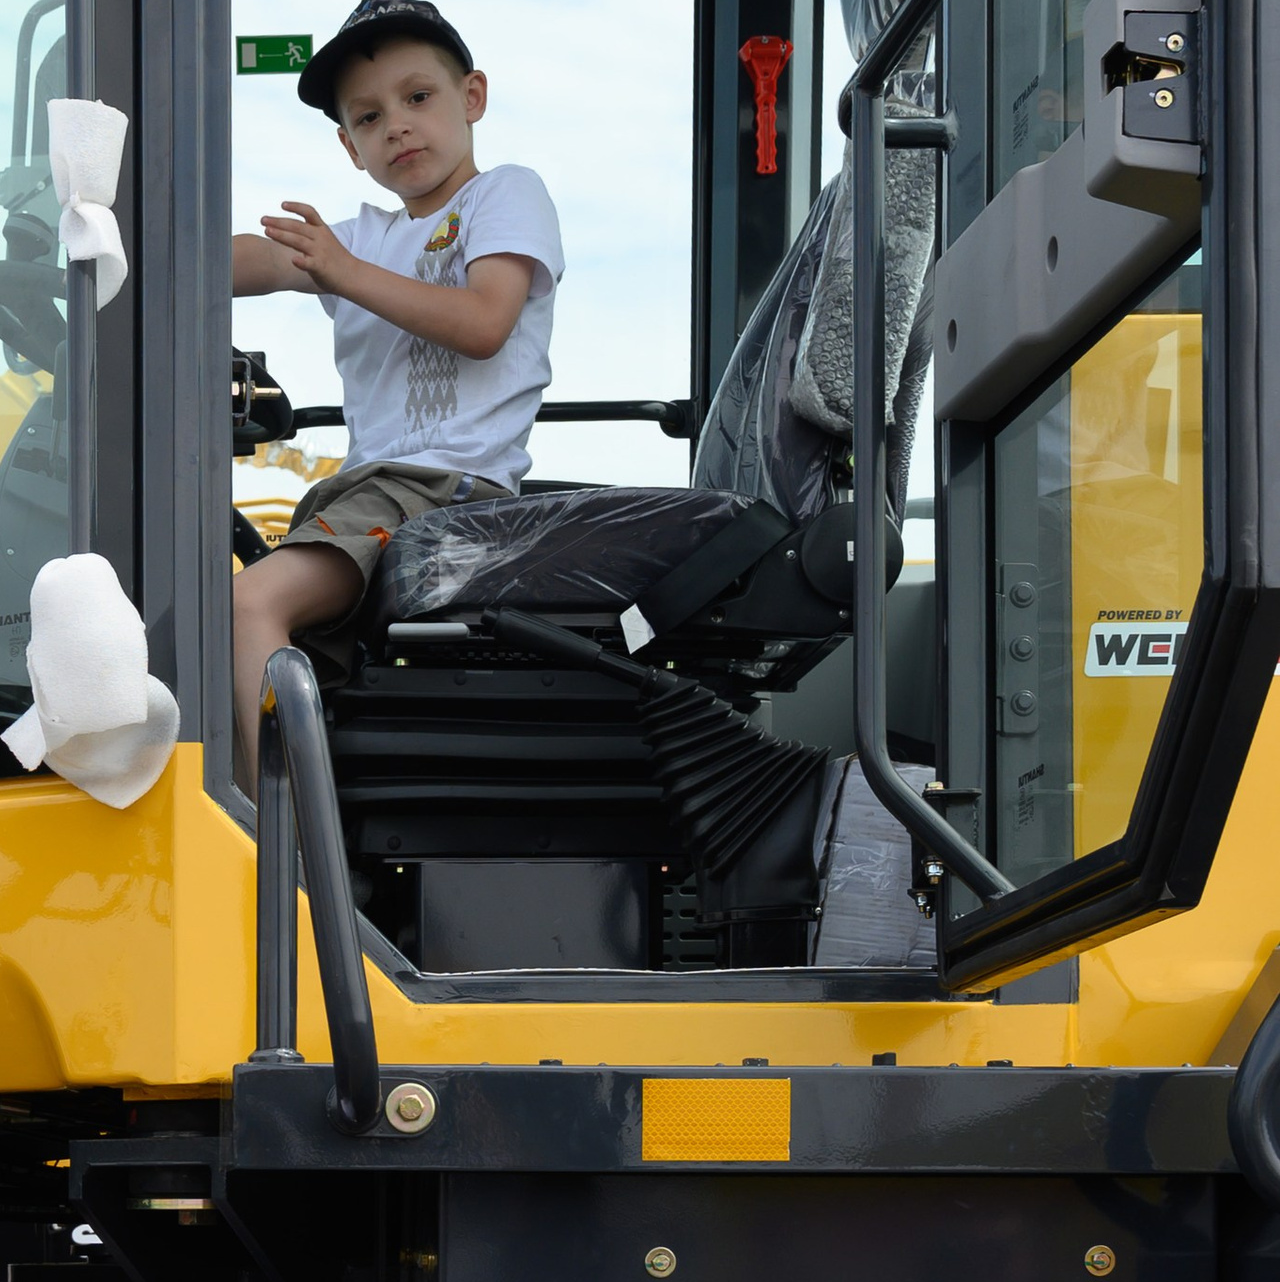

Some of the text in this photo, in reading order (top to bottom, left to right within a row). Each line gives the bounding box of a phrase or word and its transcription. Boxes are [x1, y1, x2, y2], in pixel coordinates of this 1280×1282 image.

[376, 3, 415, 15] AREA
[1097, 609, 1183, 621] POWERED BY
